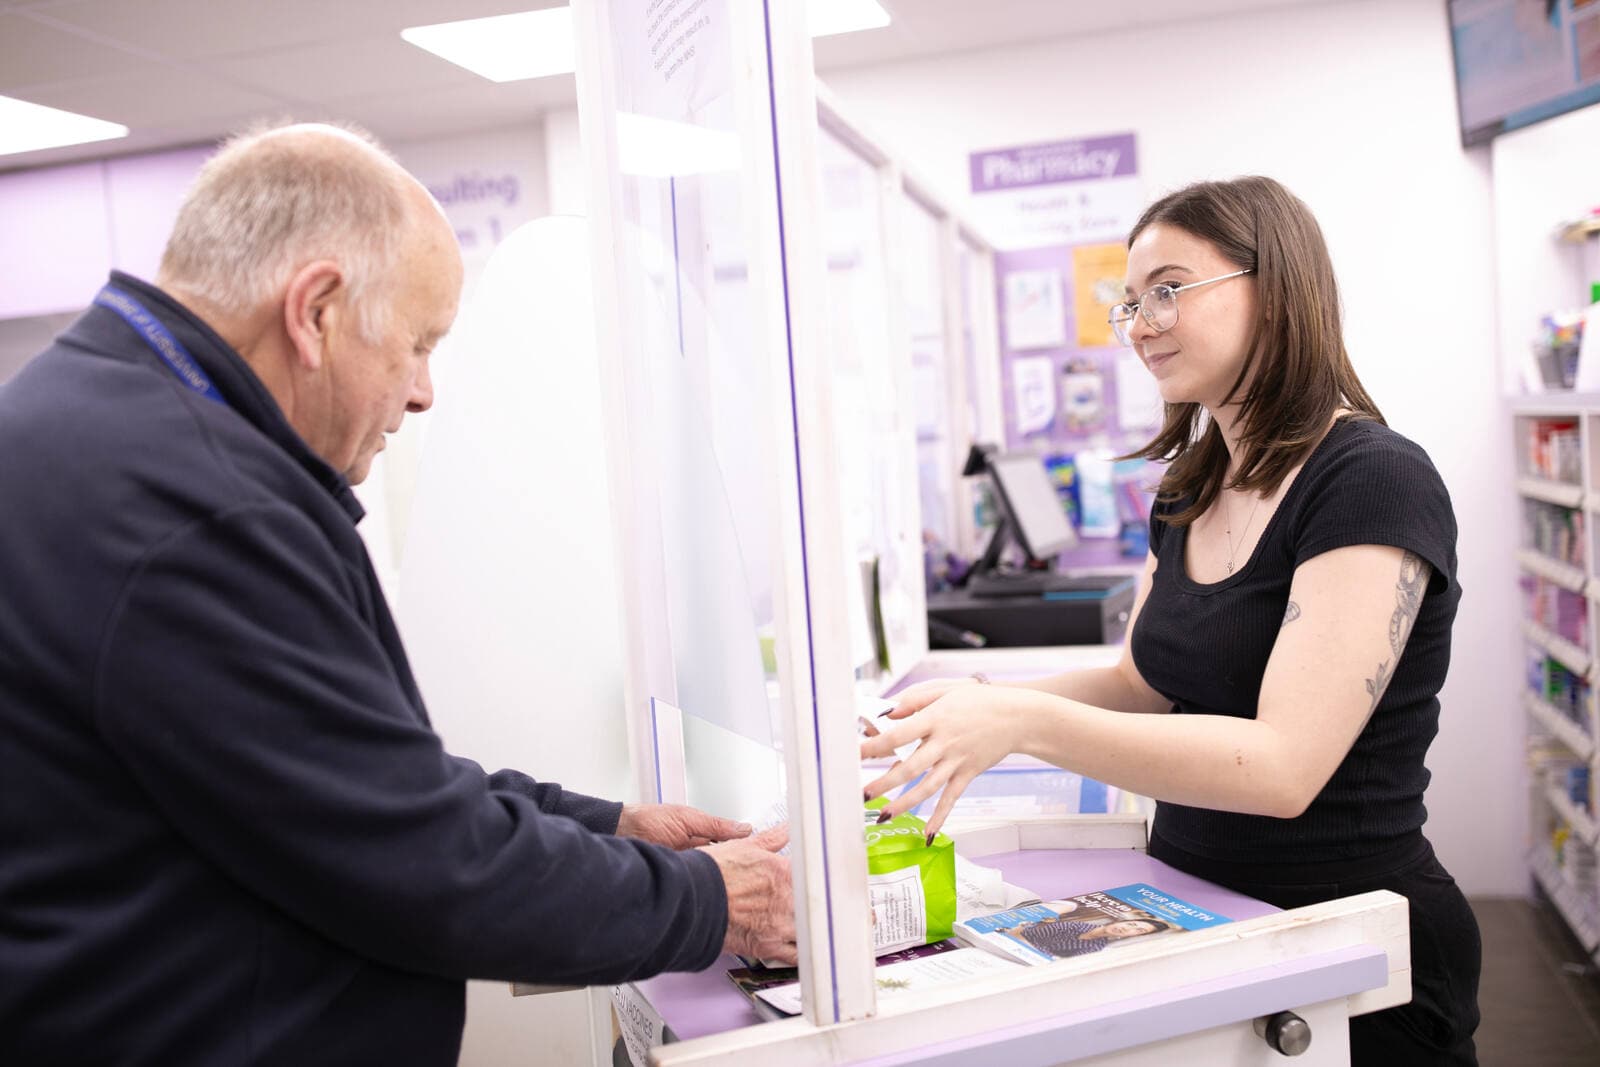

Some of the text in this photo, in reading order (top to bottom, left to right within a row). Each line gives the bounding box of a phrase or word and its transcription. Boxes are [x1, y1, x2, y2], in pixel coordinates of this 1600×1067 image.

[982, 149, 1122, 187] Pharmacy
[1137, 887, 1169, 904] YOUR
[1166, 900, 1216, 922] HEALTH
